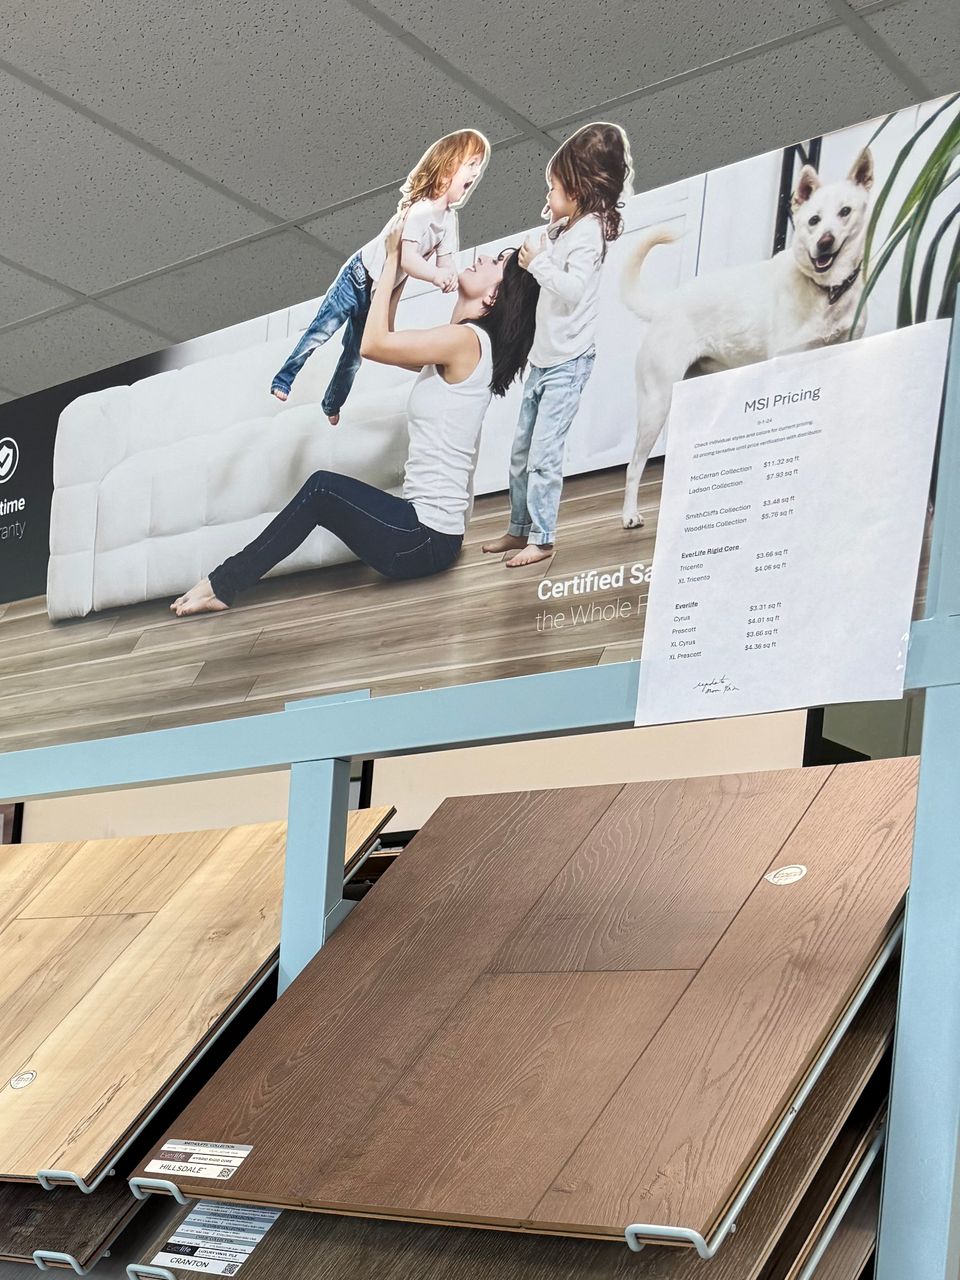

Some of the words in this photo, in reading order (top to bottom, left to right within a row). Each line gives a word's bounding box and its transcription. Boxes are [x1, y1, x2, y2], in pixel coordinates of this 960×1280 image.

[744, 397, 769, 413] MSI
[773, 387, 821, 407] Pricing
[694, 441, 708, 449] Check
[690, 472, 720, 482] McCarran
[720, 466, 752, 476] Collection
[764, 460, 784, 468] $11.32
[688, 485, 711, 494] Ladson
[711, 480, 744, 490] Collection
[766, 472, 784, 480] $7.93
[720, 504, 752, 514] Collection
[762, 498, 780, 507] $3.48
[684, 523, 715, 534] WoodHills
[715, 518, 747, 528] Collection
[681, 550, 706, 559] EverLife
[706, 547, 723, 556] Rigid
[724, 544, 740, 552] Core
[680, 563, 704, 572] Tricento
[756, 551, 774, 560] $3.66
[537, 565, 624, 600] Certified
[686, 575, 710, 584] Tricento
[535, 610, 565, 632] the
[570, 596, 632, 626] Whole
[749, 604, 766, 612] $3.31
[672, 626, 696, 634] Prescott
[678, 640, 696, 648] Cyrus
[677, 651, 702, 660] Prescott
[159, 1163, 203, 1174] HILLSDALE
[170, 1257, 210, 1268] CRANTON
